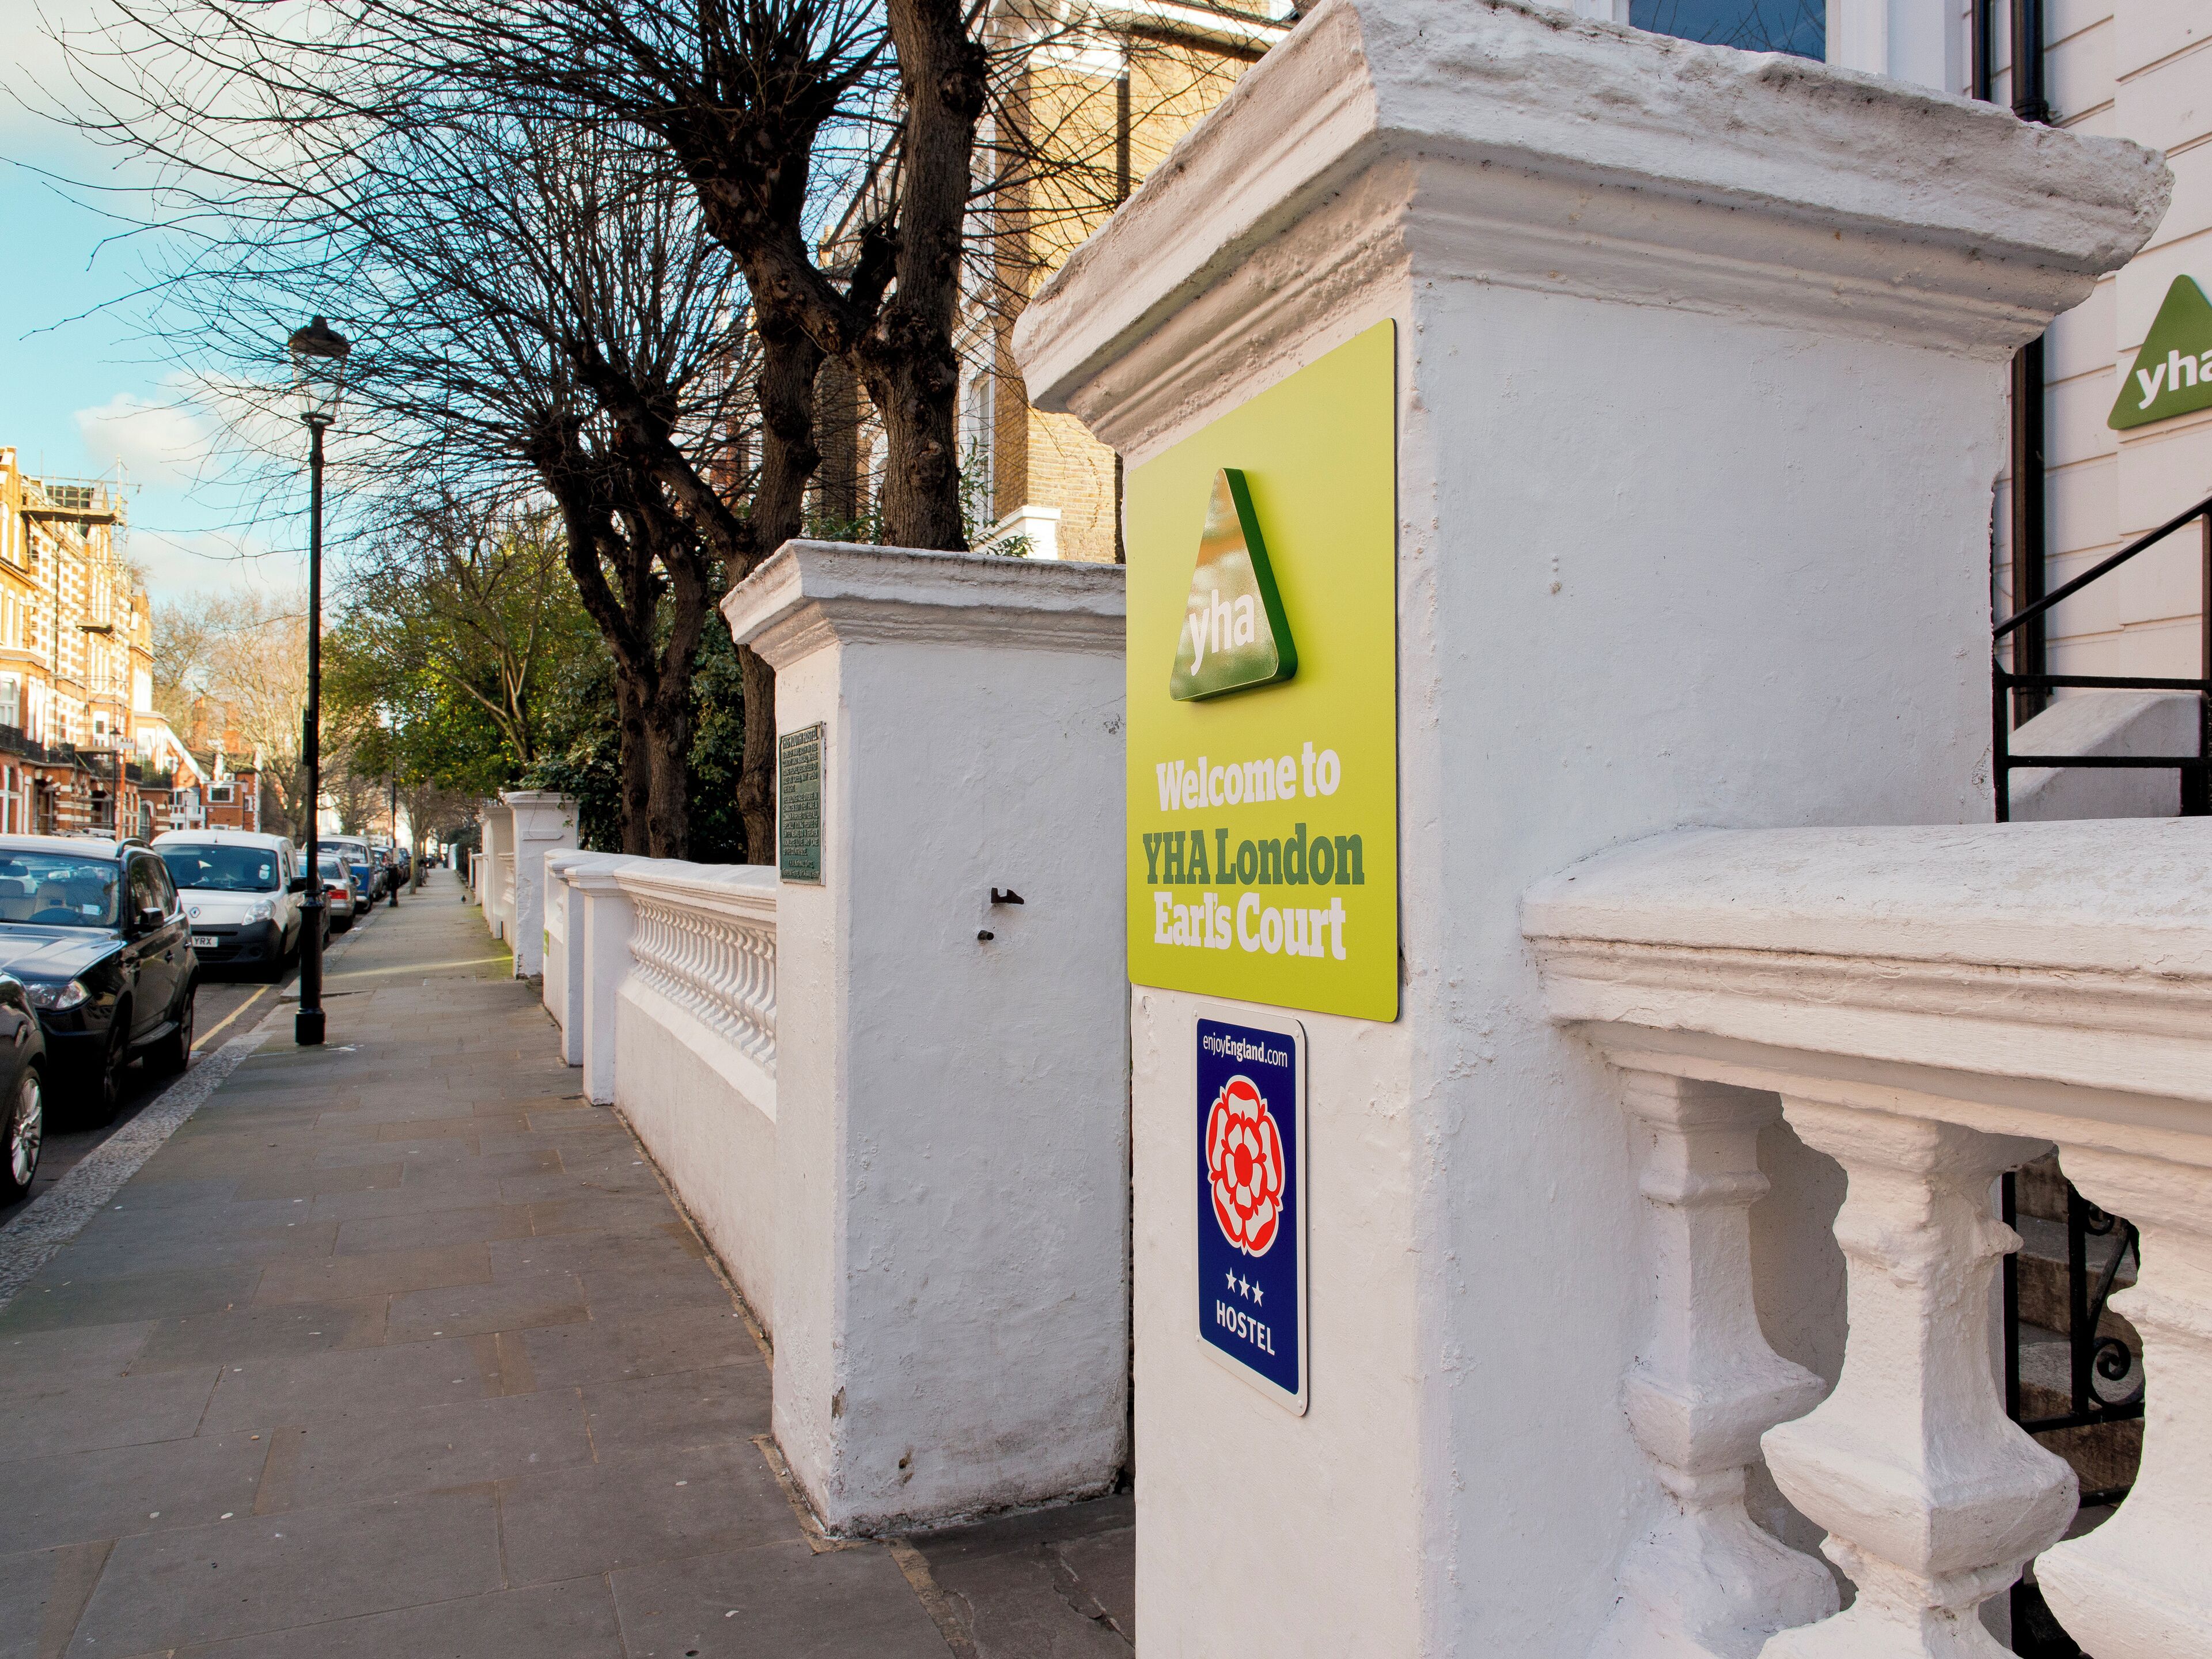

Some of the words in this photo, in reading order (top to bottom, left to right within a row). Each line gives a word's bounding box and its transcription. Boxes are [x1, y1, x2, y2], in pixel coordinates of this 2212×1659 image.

[2136, 350, 2212, 410] yha
[1189, 589, 1255, 676] yha
[791, 732, 803, 747] YOUTH
[803, 728, 818, 743] HOSTEL
[1156, 756, 1296, 811] Welcome
[1301, 741, 1340, 797] to
[1143, 830, 1210, 884] YHA
[1215, 823, 1365, 885] London
[1154, 892, 1232, 950] Earl's
[1237, 892, 1346, 960] Court
[1203, 1032, 1288, 1067] enjoyEngland.com
[1217, 1300, 1275, 1356] HOSTEL
